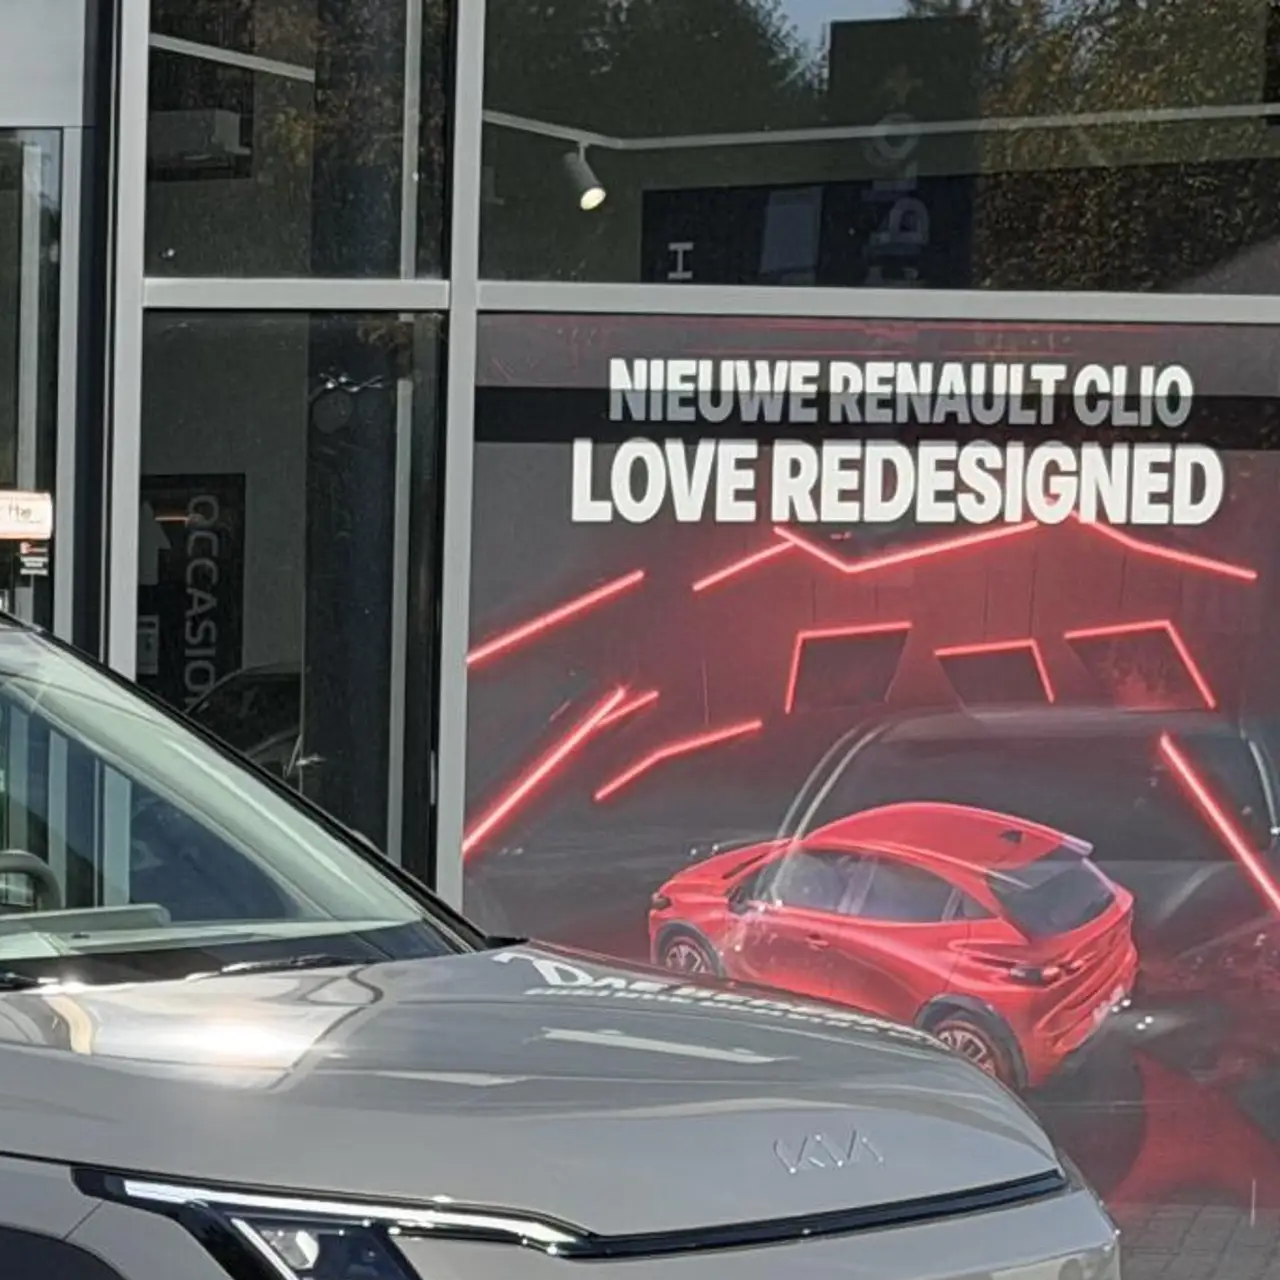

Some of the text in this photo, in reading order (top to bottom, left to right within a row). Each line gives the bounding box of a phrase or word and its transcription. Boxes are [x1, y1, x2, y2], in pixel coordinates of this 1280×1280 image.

[608, 357, 1194, 428] NIEUWE RENAULT CLIO
[571, 436, 1225, 526] LOVE REDESIGNED
